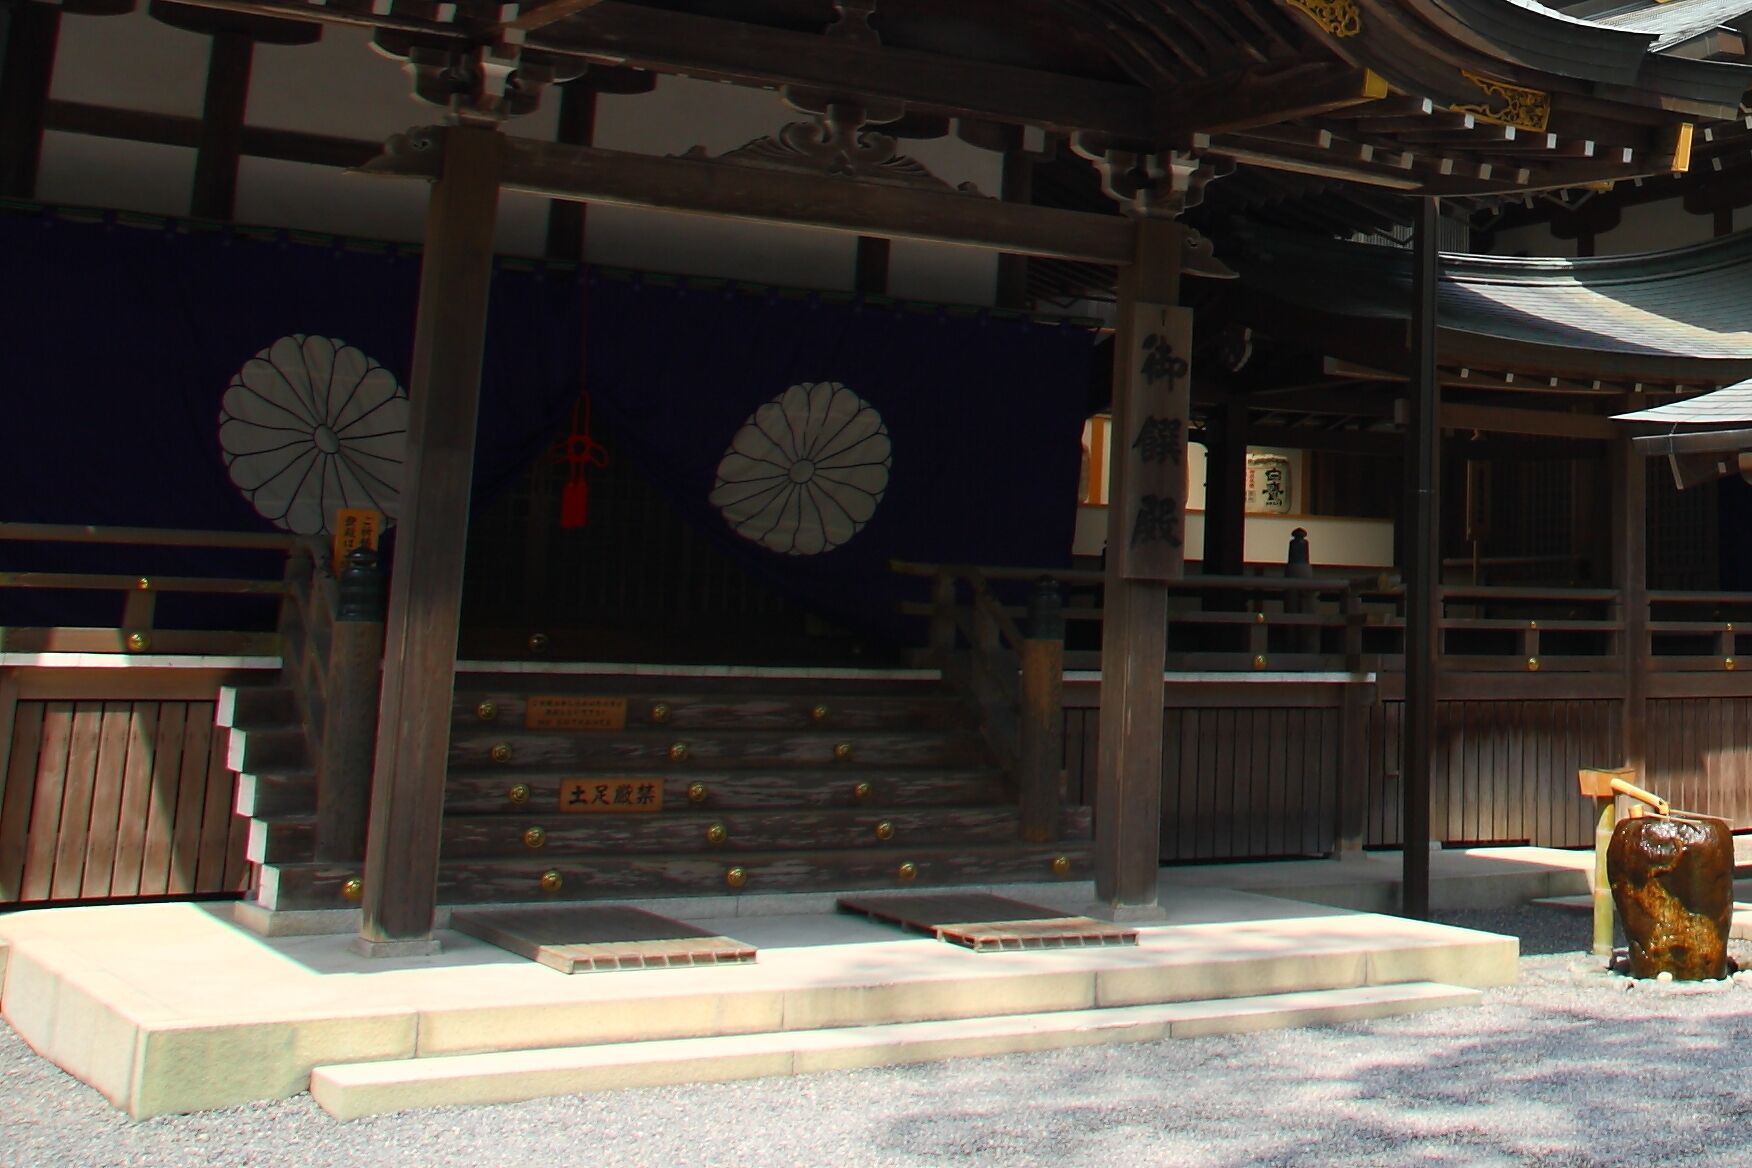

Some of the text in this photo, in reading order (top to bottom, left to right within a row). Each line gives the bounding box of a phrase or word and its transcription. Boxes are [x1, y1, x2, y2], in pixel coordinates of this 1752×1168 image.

[1132, 334, 1187, 550] 御饌殿
[568, 783, 656, 805] 土足厳禁
